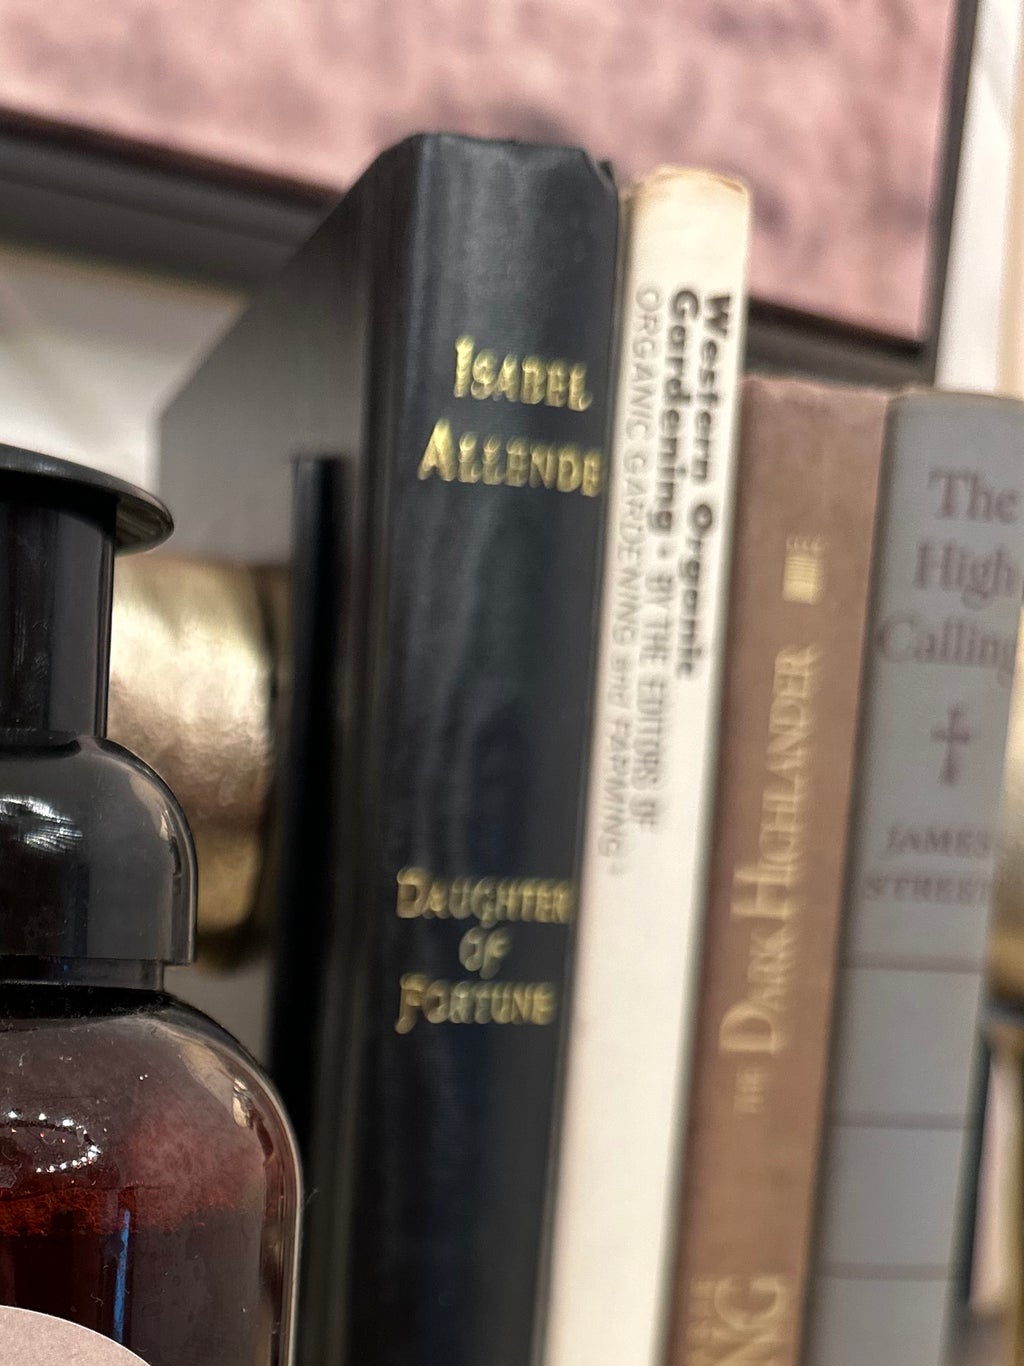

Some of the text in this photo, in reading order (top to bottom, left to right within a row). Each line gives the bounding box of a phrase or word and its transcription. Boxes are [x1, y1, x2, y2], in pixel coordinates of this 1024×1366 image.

[454, 334, 594, 412] ISABEL
[626, 284, 661, 441] ORGANIC
[647, 287, 698, 538] Gardening
[417, 418, 602, 497] ALLENDE
[676, 292, 732, 682] Western Organic
[928, 467, 1020, 524] The
[610, 450, 648, 646] GARDENING
[914, 538, 1020, 611] High
[396, 867, 573, 928] DAUGHTER
[458, 925, 513, 980] OF
[394, 973, 558, 1035] FORTUNE
